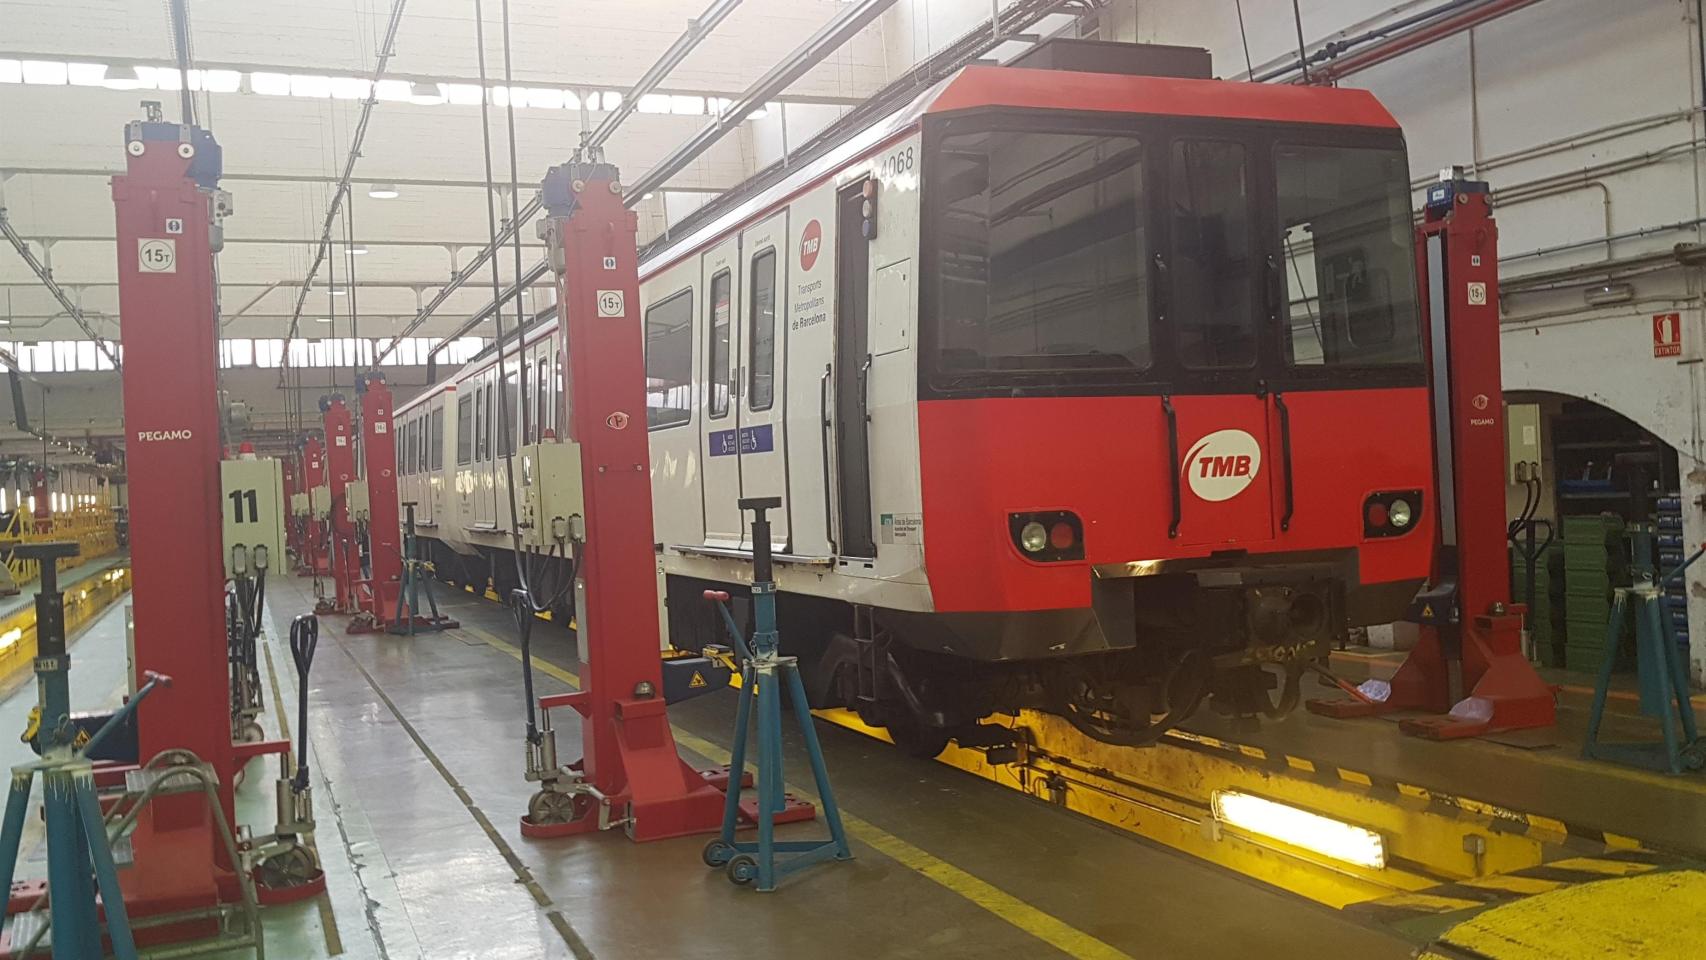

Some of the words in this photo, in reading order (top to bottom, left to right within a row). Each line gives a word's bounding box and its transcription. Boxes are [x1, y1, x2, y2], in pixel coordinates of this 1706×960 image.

[880, 146, 914, 181] 4068
[803, 237, 819, 256] TMB
[798, 279, 822, 296] Transports
[794, 296, 825, 313] Metropolitans
[792, 319, 799, 331] de
[799, 313, 826, 329] Barcelona
[138, 429, 192, 441] PEGAMO
[1199, 455, 1251, 478] TMB
[229, 489, 258, 523] 11
